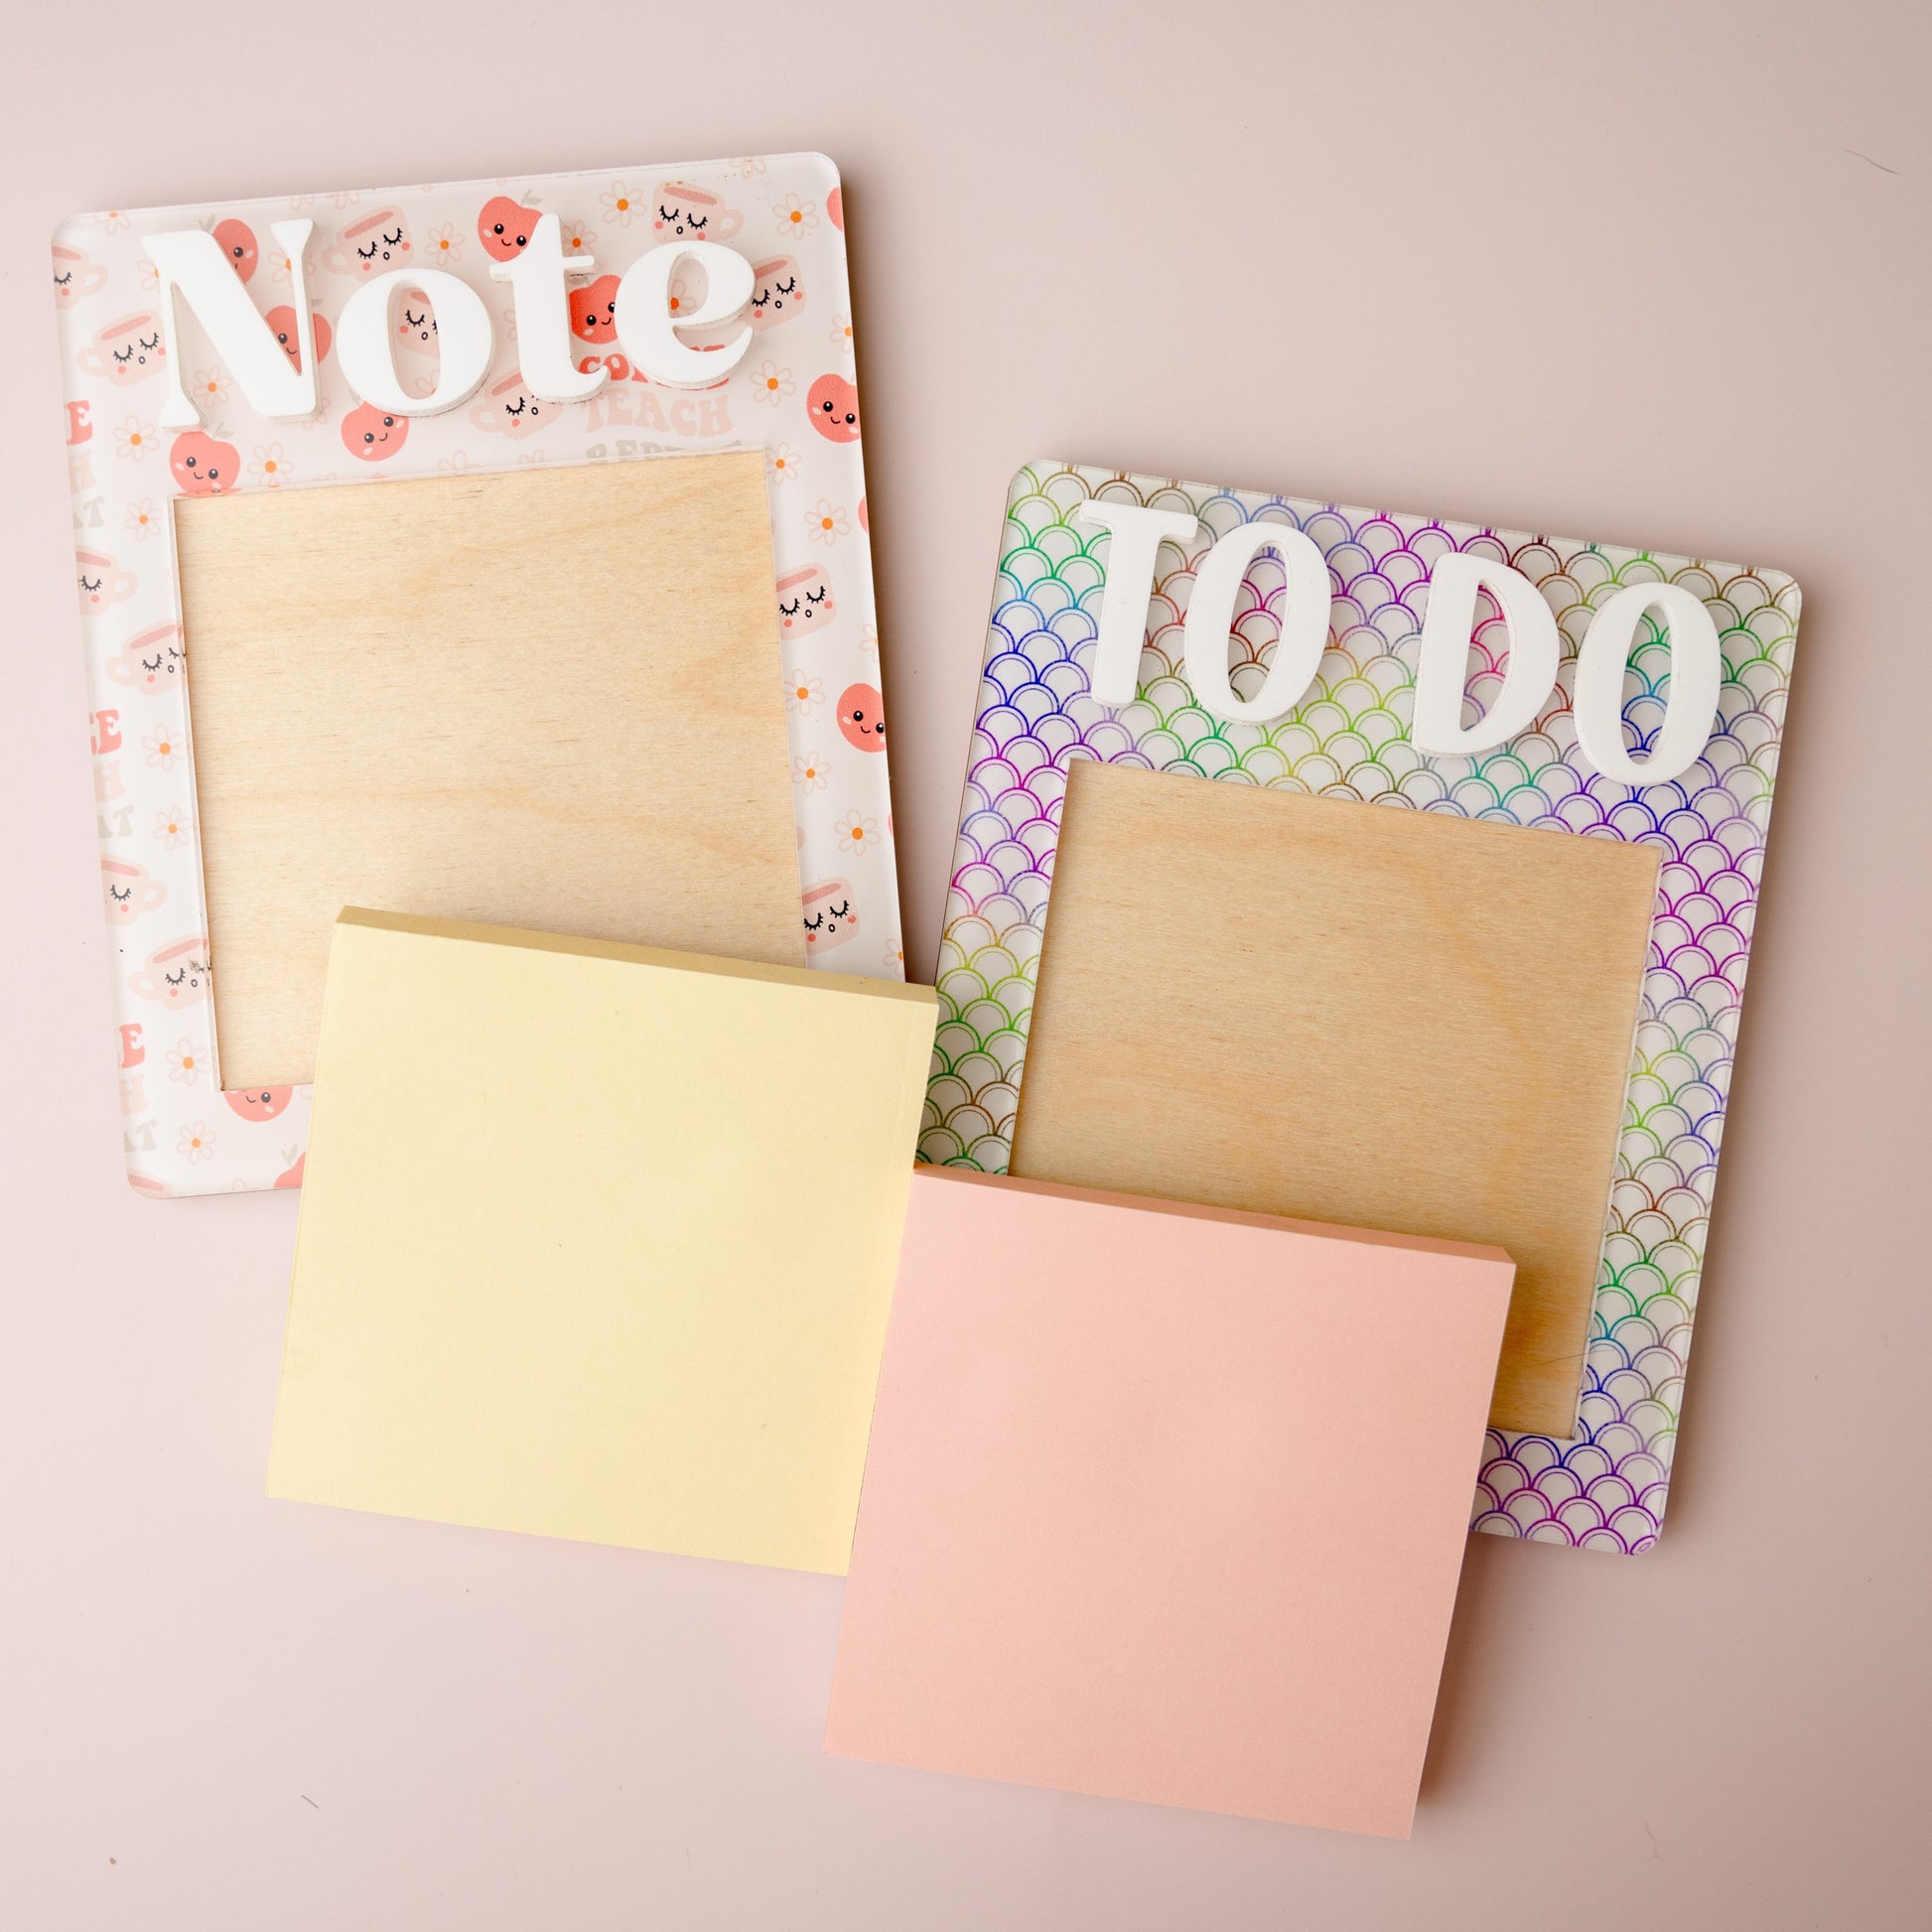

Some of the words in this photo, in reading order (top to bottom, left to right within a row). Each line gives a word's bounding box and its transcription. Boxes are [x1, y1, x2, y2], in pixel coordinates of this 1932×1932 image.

[140, 212, 756, 430] Note
[581, 387, 734, 438] TEACH
[1079, 499, 1332, 725] TO
[1412, 552, 1722, 785] DO
